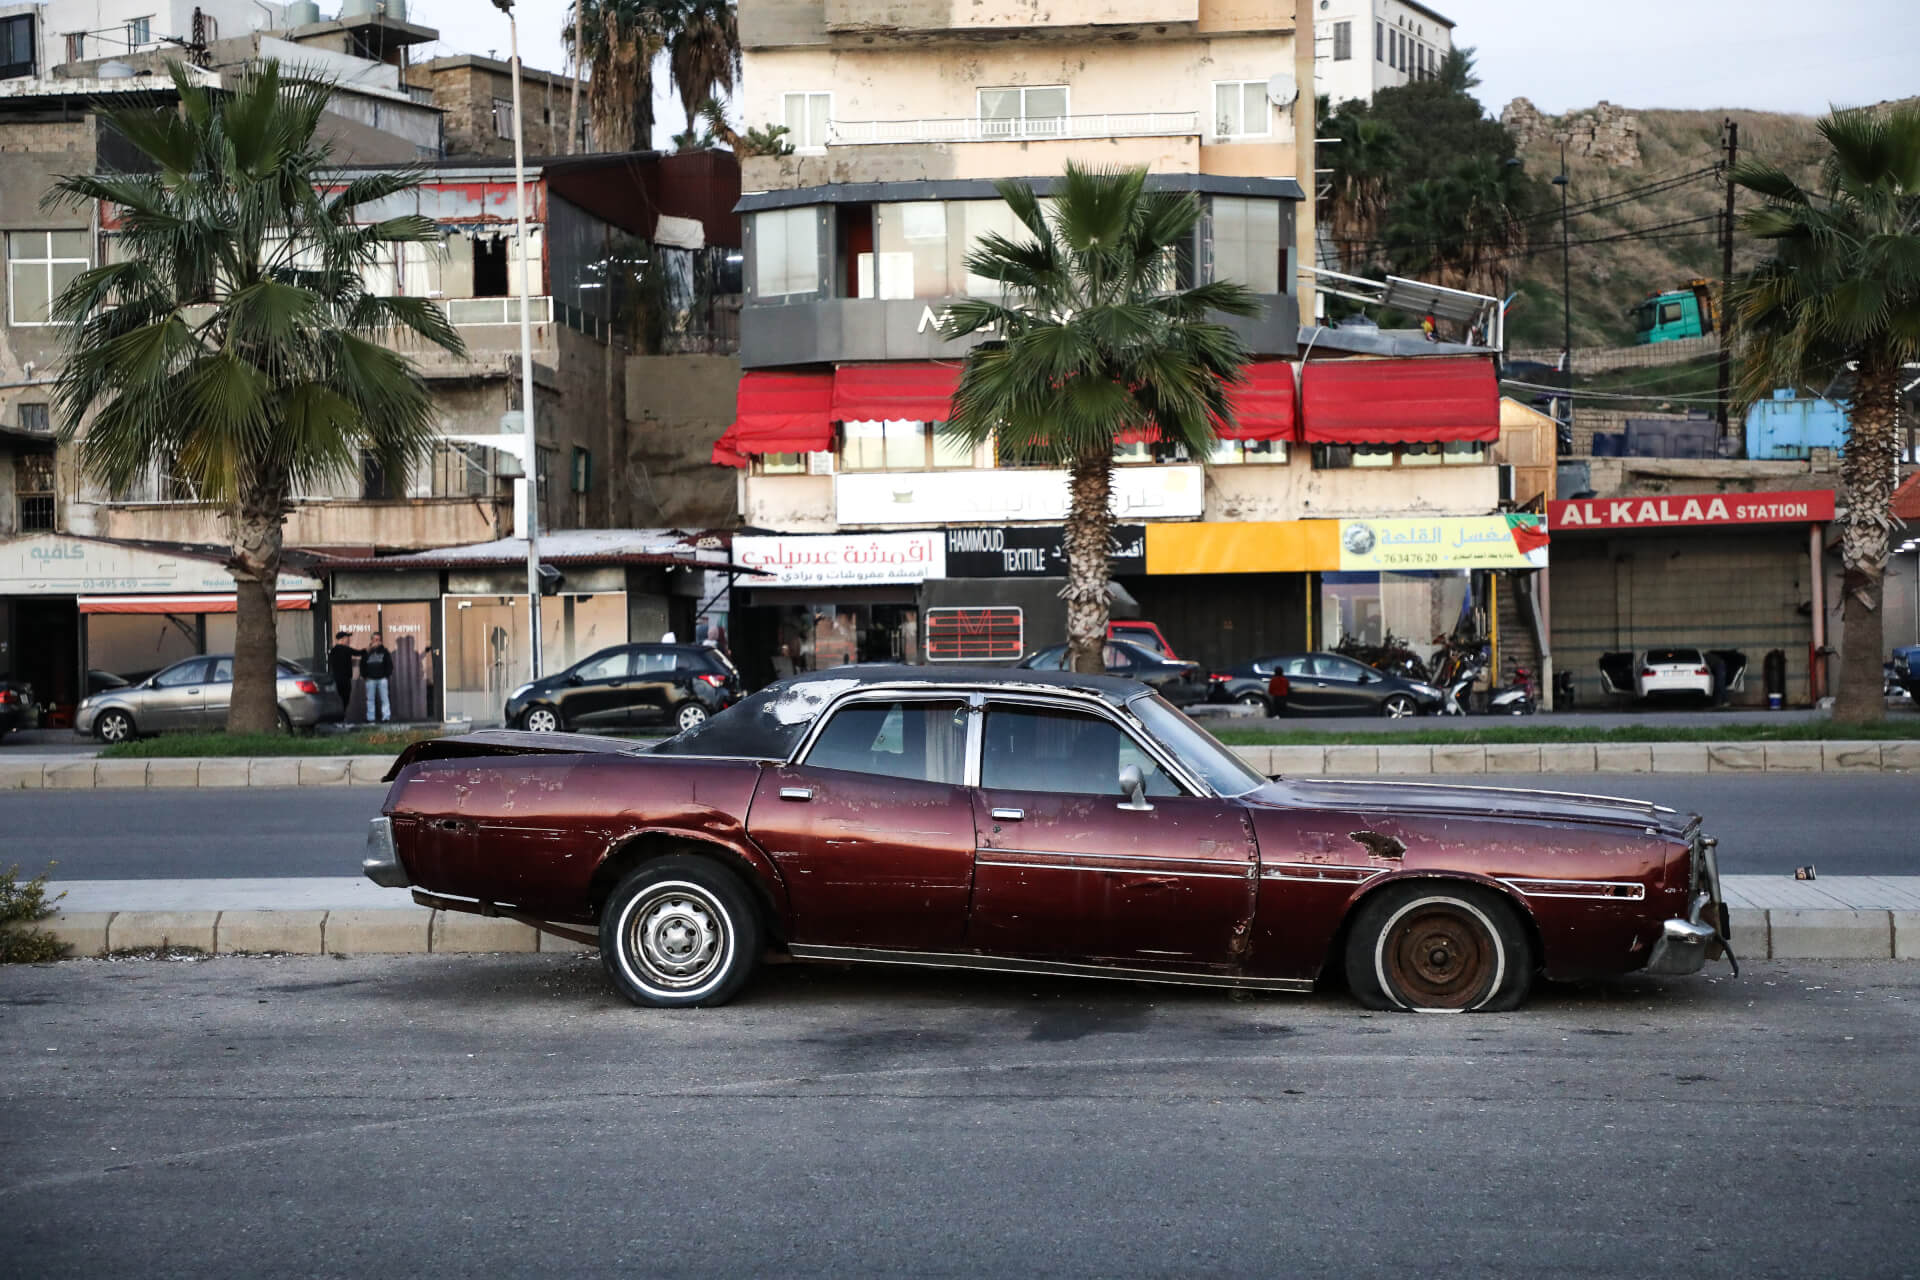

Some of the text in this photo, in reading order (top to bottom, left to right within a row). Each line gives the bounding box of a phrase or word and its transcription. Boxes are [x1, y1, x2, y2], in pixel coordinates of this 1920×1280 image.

[1560, 498, 1807, 525] AL-KALAA STATION
[949, 529, 1005, 552] HAMMOUD
[1002, 548, 1046, 571] TEXTTILE
